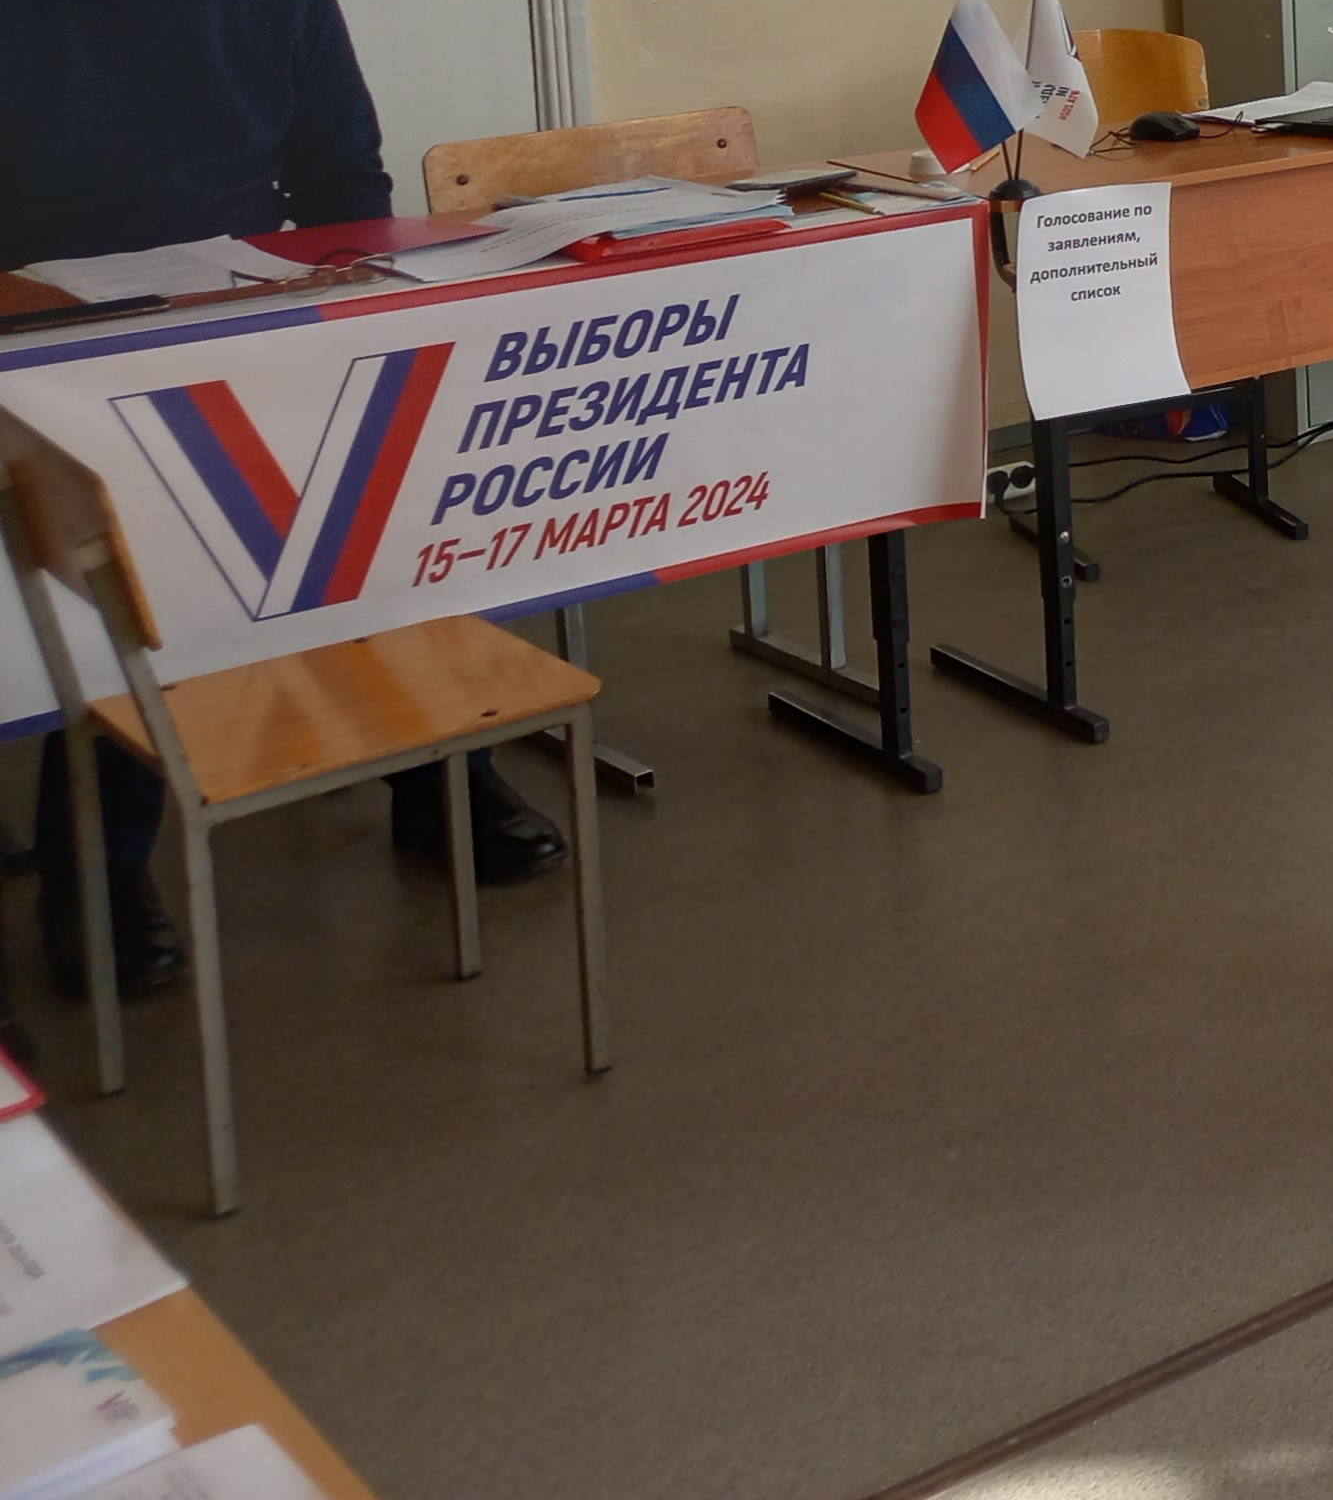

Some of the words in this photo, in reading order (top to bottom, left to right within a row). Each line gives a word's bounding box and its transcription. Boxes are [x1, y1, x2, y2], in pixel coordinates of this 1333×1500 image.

[1036, 206, 1131, 228] Голосование
[1134, 203, 1152, 218] по
[1047, 230, 1141, 252] заявлениям,
[1030, 253, 1158, 284] дополнительный
[1071, 285, 1121, 301] список
[483, 294, 741, 384] ВЫБОРЫ
[457, 342, 809, 455] ПРЕЗИДЕНТА
[431, 432, 671, 526] РОССИИ
[531, 490, 672, 562] МАРТА
[677, 470, 771, 532] 2024
